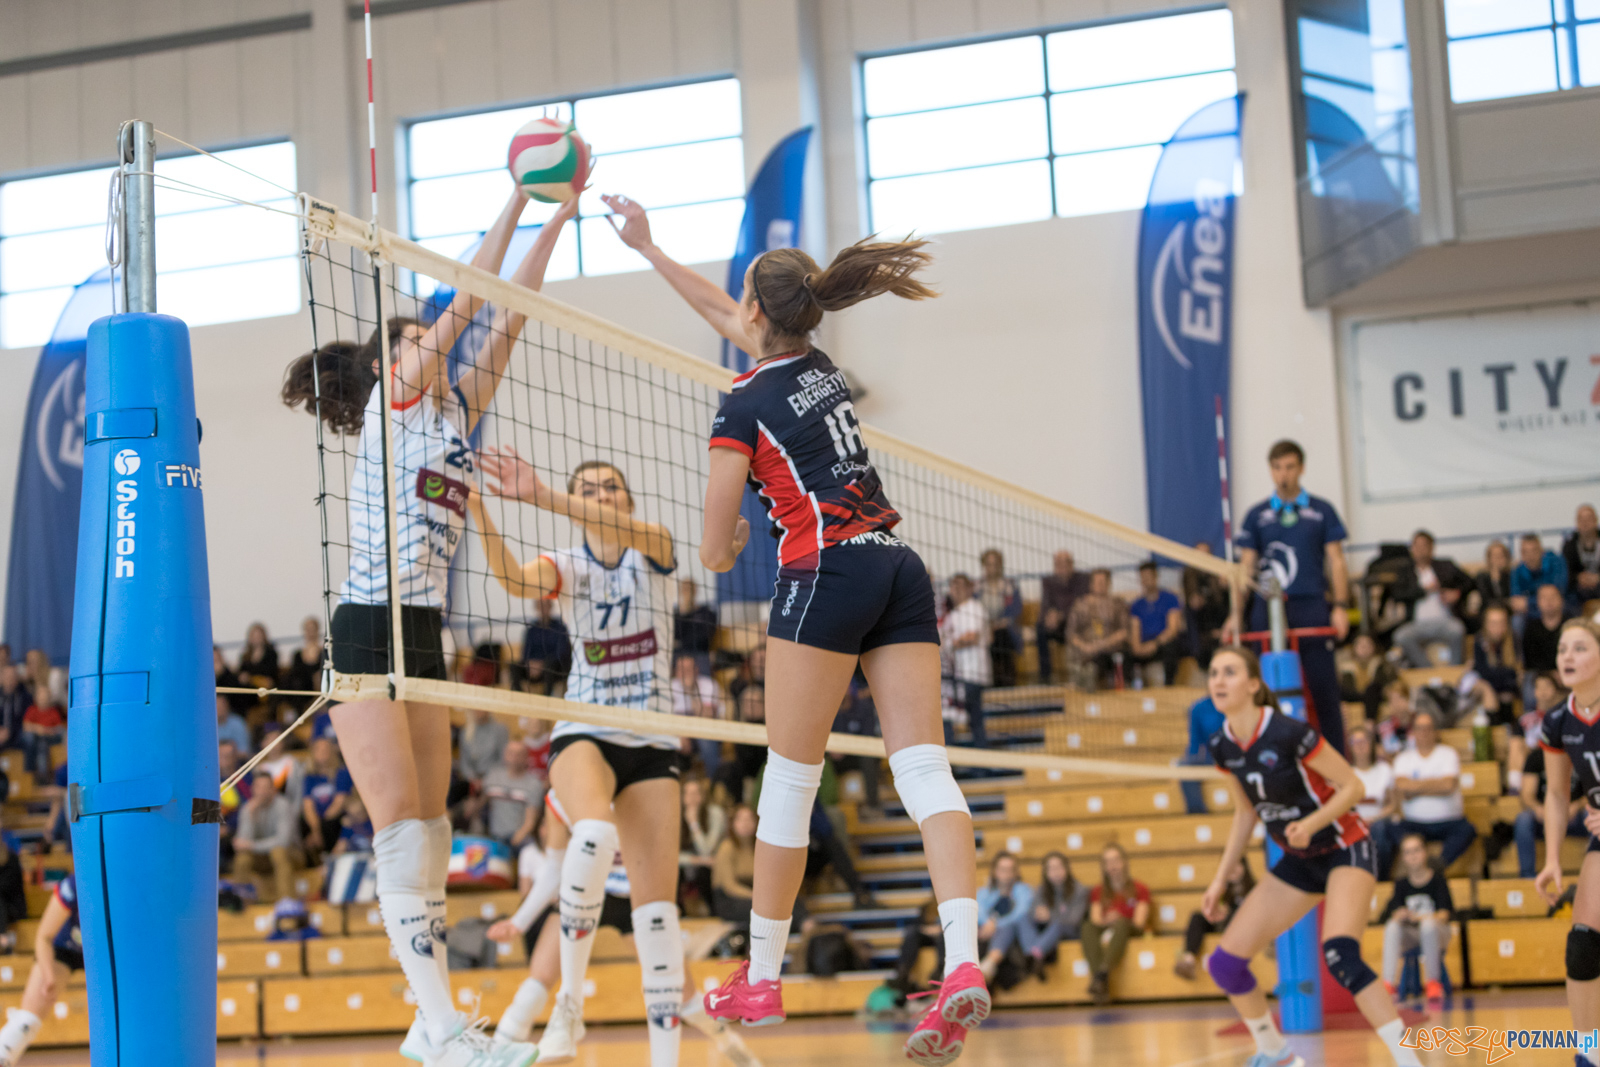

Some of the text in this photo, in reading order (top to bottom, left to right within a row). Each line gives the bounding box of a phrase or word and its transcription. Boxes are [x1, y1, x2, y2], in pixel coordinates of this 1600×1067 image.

[1179, 178, 1227, 344] Enea
[1393, 357, 1568, 422] CITY
[824, 401, 867, 461] 16
[115, 480, 138, 577] Senoh
